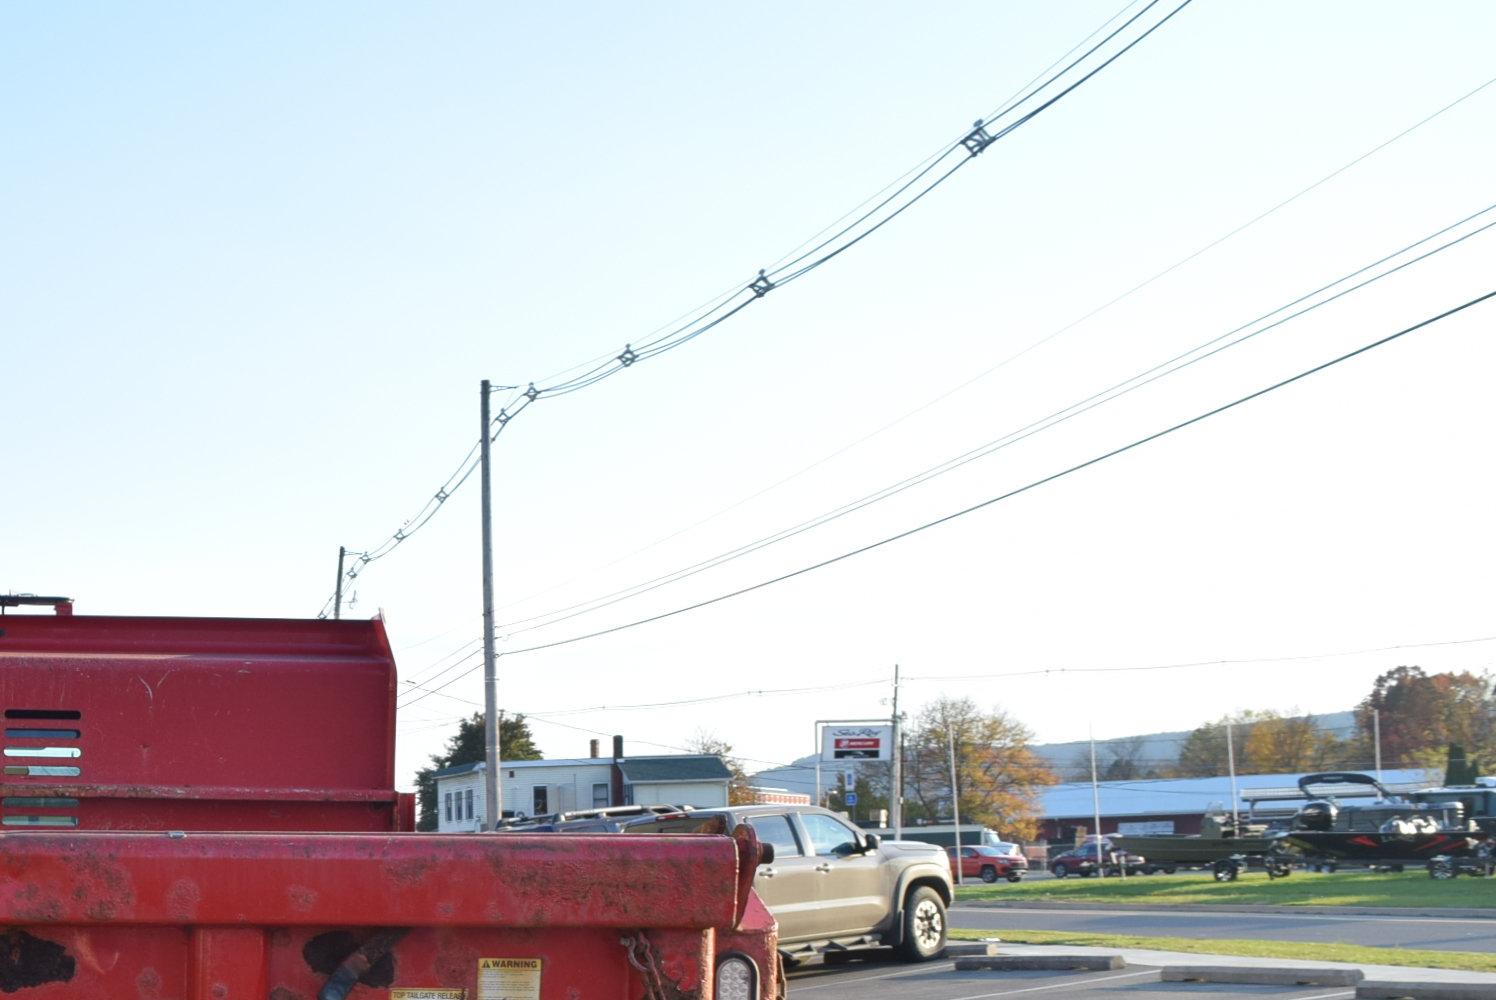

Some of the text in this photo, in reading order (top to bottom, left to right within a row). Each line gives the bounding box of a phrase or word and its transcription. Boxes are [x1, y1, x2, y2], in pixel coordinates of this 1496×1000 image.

[491, 960, 538, 969] WARNING
[407, 992, 436, 1000] TAILGATE
[437, 992, 465, 1000] RELEAS
